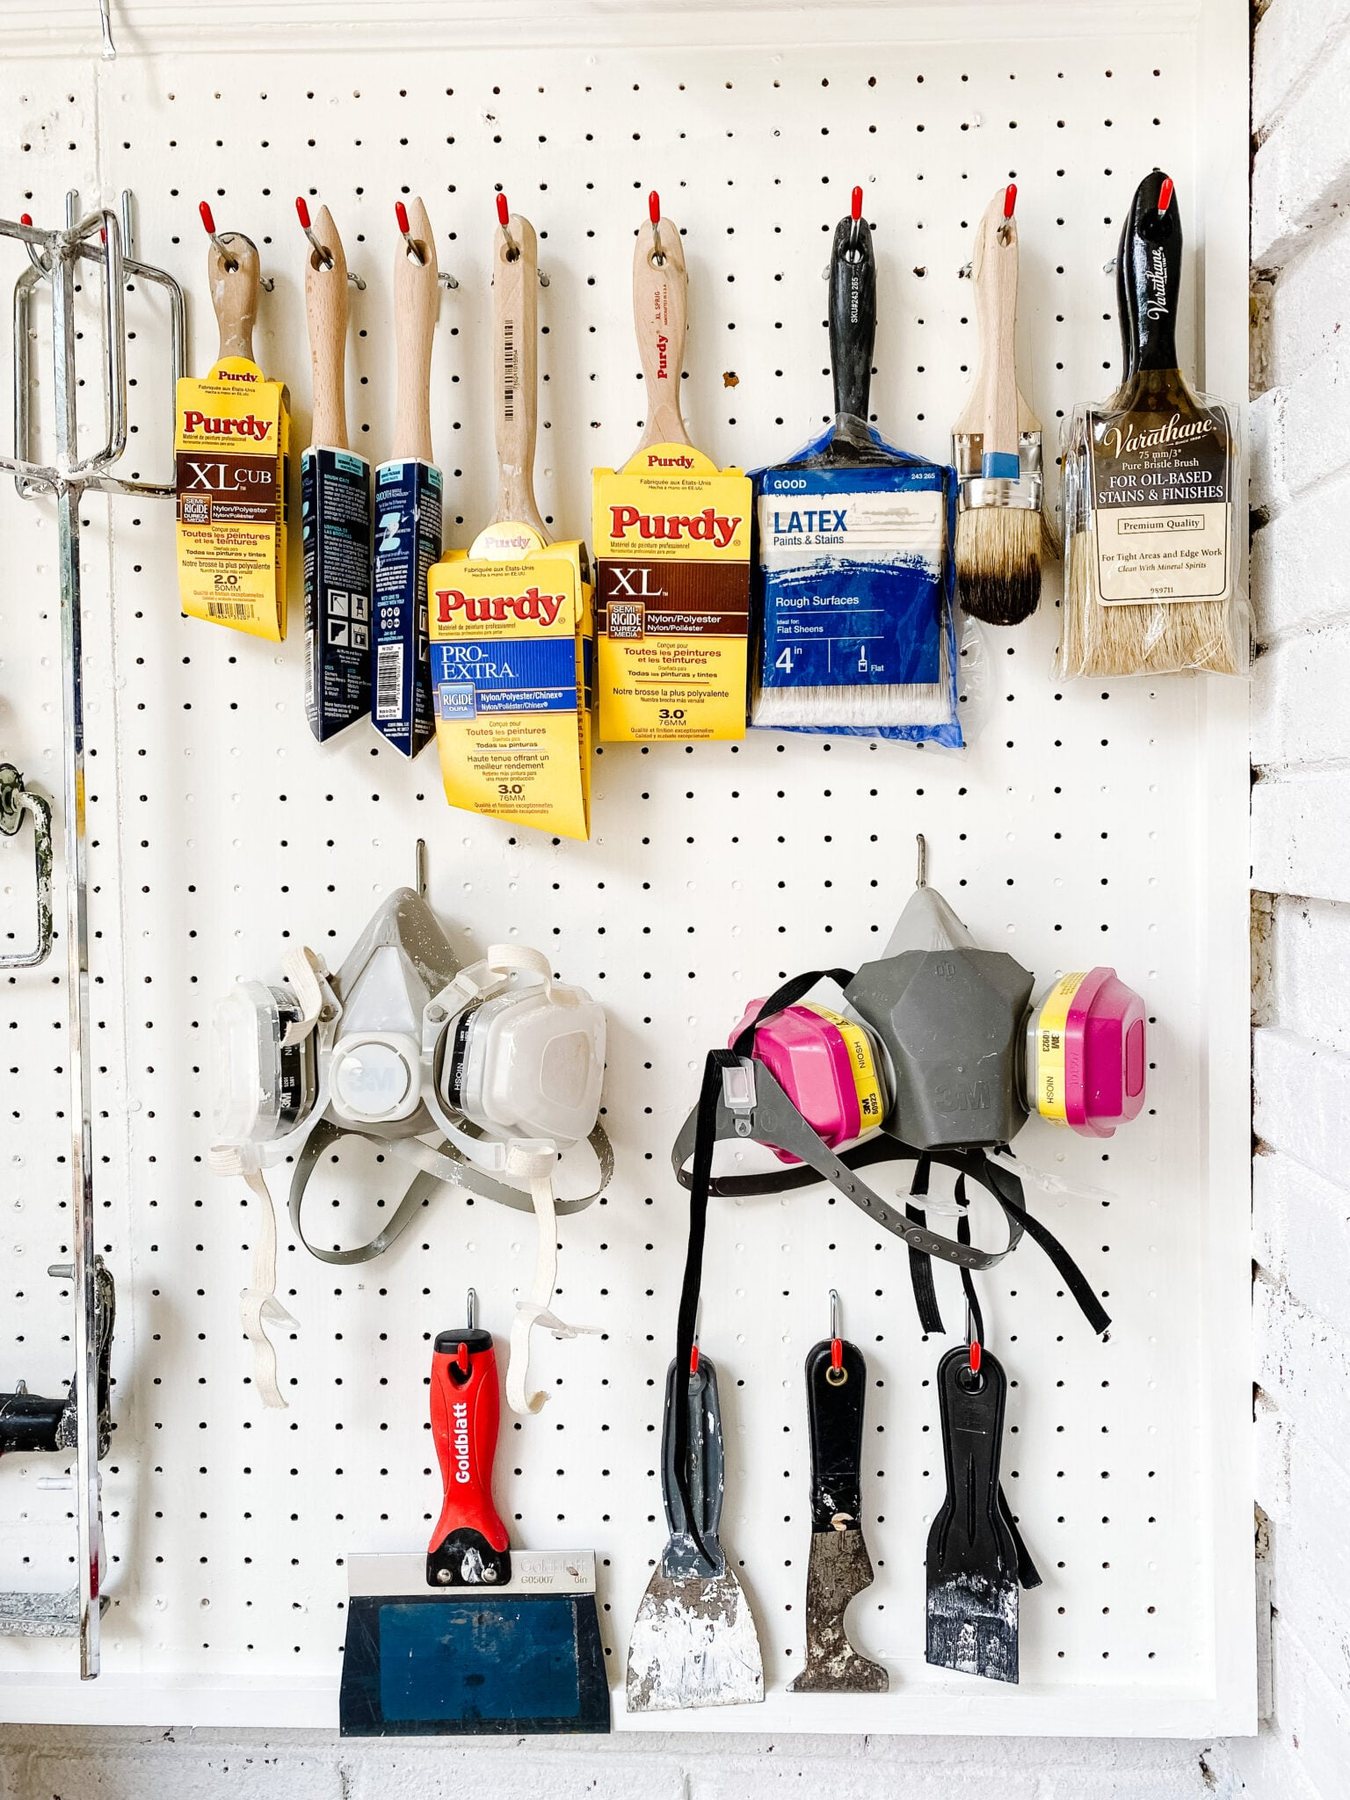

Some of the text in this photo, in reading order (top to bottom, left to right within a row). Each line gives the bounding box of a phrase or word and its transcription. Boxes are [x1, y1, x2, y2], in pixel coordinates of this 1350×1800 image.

[1148, 249, 1169, 320] Varathane
[657, 334, 668, 379] Purdy
[218, 371, 258, 382] Purdy
[184, 411, 272, 441] Purdy
[1104, 413, 1214, 459] Varathane
[648, 455, 694, 469] Purdy
[1139, 451, 1149, 459] 75
[1122, 458, 1199, 471] Pure Bristle Brush
[186, 462, 272, 490] XL CUB
[1110, 471, 1212, 489] FOR OIL-BASED
[774, 479, 807, 489] GOOD
[1099, 486, 1224, 503] STAINS & FINISHES
[184, 504, 208, 514] RIGIDE
[610, 506, 742, 548] Purdy
[774, 510, 847, 534] LATEX
[1124, 520, 1200, 530] Premium Quality
[485, 535, 530, 549] Purdy
[774, 534, 844, 546] Paints & Stains
[1101, 548, 1222, 562] For Tight Areas and Edge Work
[1139, 564, 1156, 572] With
[1185, 561, 1206, 570] Spirits
[608, 568, 663, 596] XL
[436, 588, 565, 626] Purdy
[776, 595, 859, 608] Rough Surfaces
[611, 613, 641, 626] RIGIDE
[647, 615, 721, 624] Nylon/Polyester
[441, 646, 488, 662] PRO-
[673, 649, 721, 657] peintures
[775, 646, 802, 673] 4 in
[442, 662, 515, 680] EXTRA
[443, 693, 473, 705] RIGIDE
[670, 689, 685, 697] plus
[687, 690, 729, 698] polyvalente
[1051, 1033, 1060, 1049] 3M
[854, 1042, 866, 1068] NIOSH
[454, 1062, 463, 1090] NIOSH
[282, 1093, 292, 1108] 3M
[862, 1099, 871, 1114] 3M
[870, 1093, 878, 1114] 60923
[452, 1402, 470, 1483] Goldblatt
